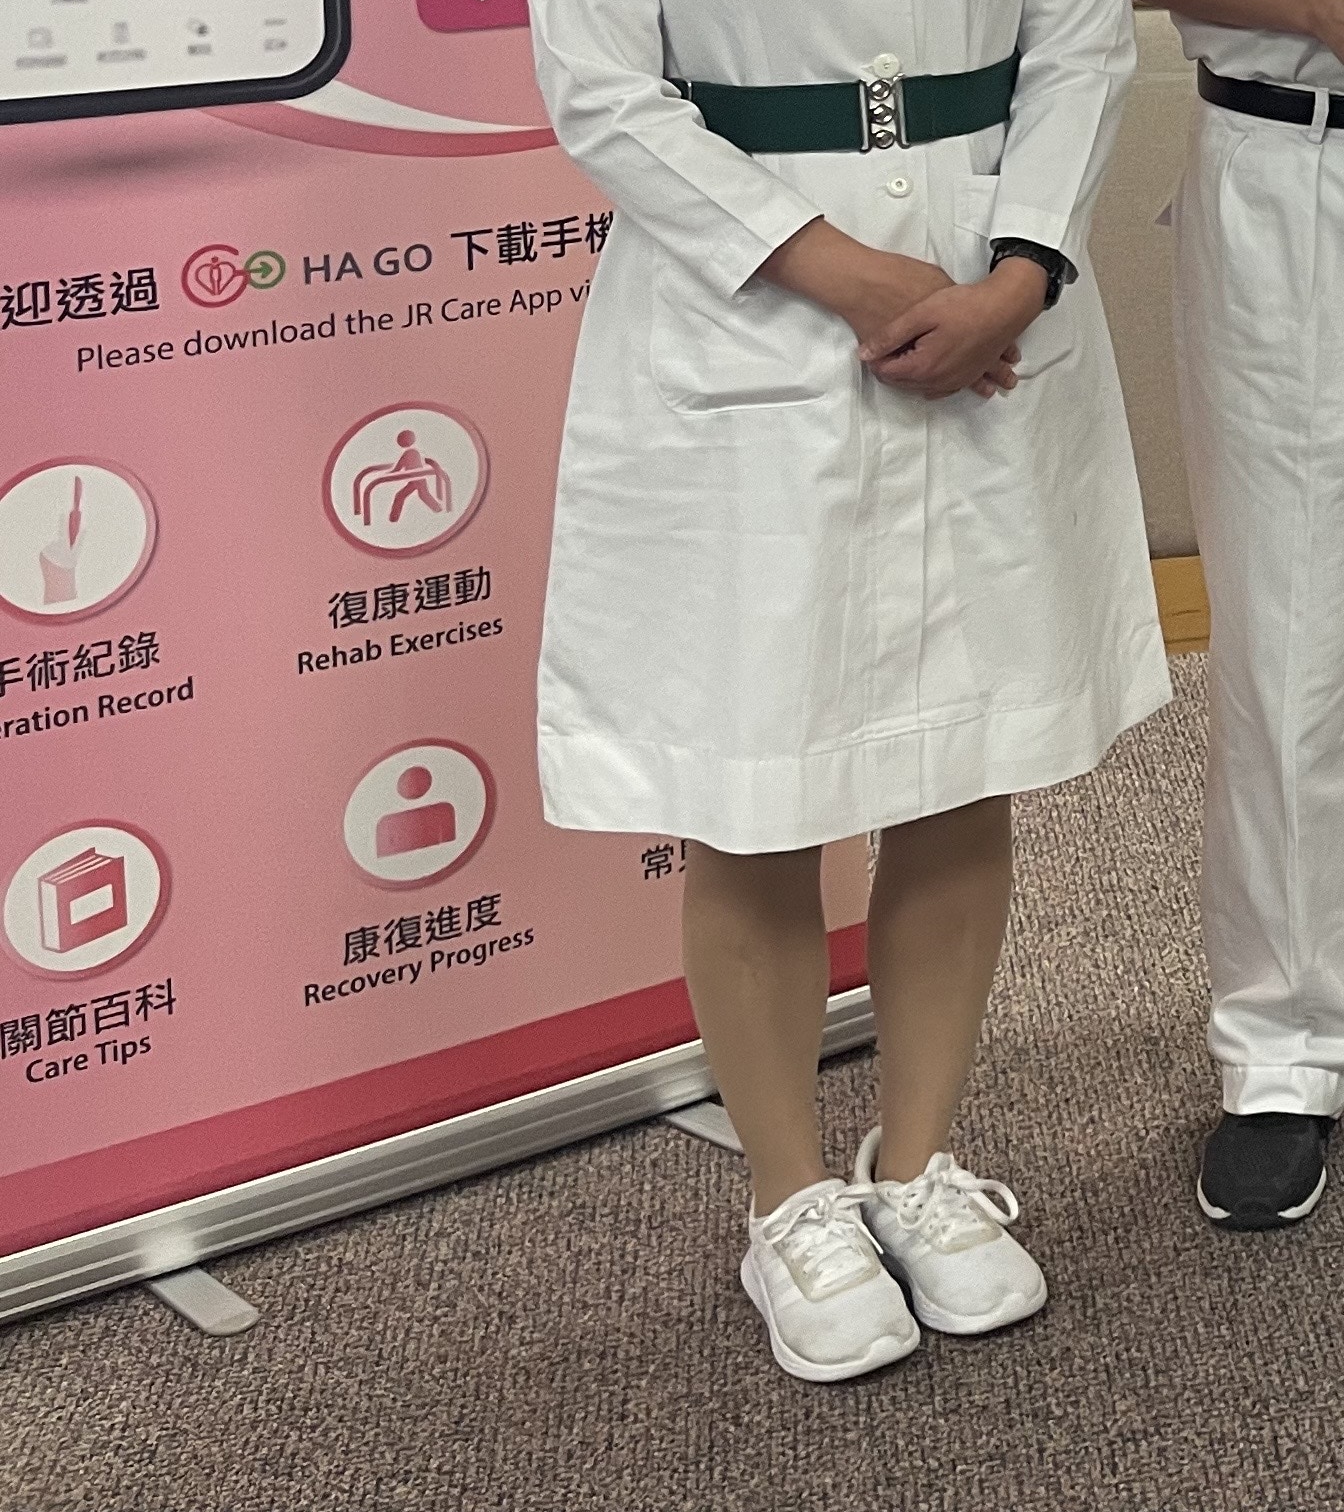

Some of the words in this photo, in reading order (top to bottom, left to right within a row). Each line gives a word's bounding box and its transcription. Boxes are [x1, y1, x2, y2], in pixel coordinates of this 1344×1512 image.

[302, 252, 363, 285] HA
[373, 243, 433, 278] GO
[0, 267, 160, 330] 迎透過
[76, 340, 175, 372] Please
[183, 315, 336, 358] download
[345, 306, 394, 337] the
[401, 301, 433, 329] JR
[440, 295, 501, 324] Care
[508, 287, 562, 322] App
[327, 566, 492, 630] 復康運動
[297, 640, 382, 674] Rehab
[390, 616, 504, 657] Exercises
[0, 705, 90, 739] ration
[98, 675, 194, 719] Record
[344, 892, 504, 967] 康復進度
[304, 958, 422, 1007] Recovery
[429, 927, 536, 979] Progress
[0, 977, 177, 1060] 關節百科
[26, 1053, 89, 1083] Care
[94, 1035, 152, 1065] Tips
